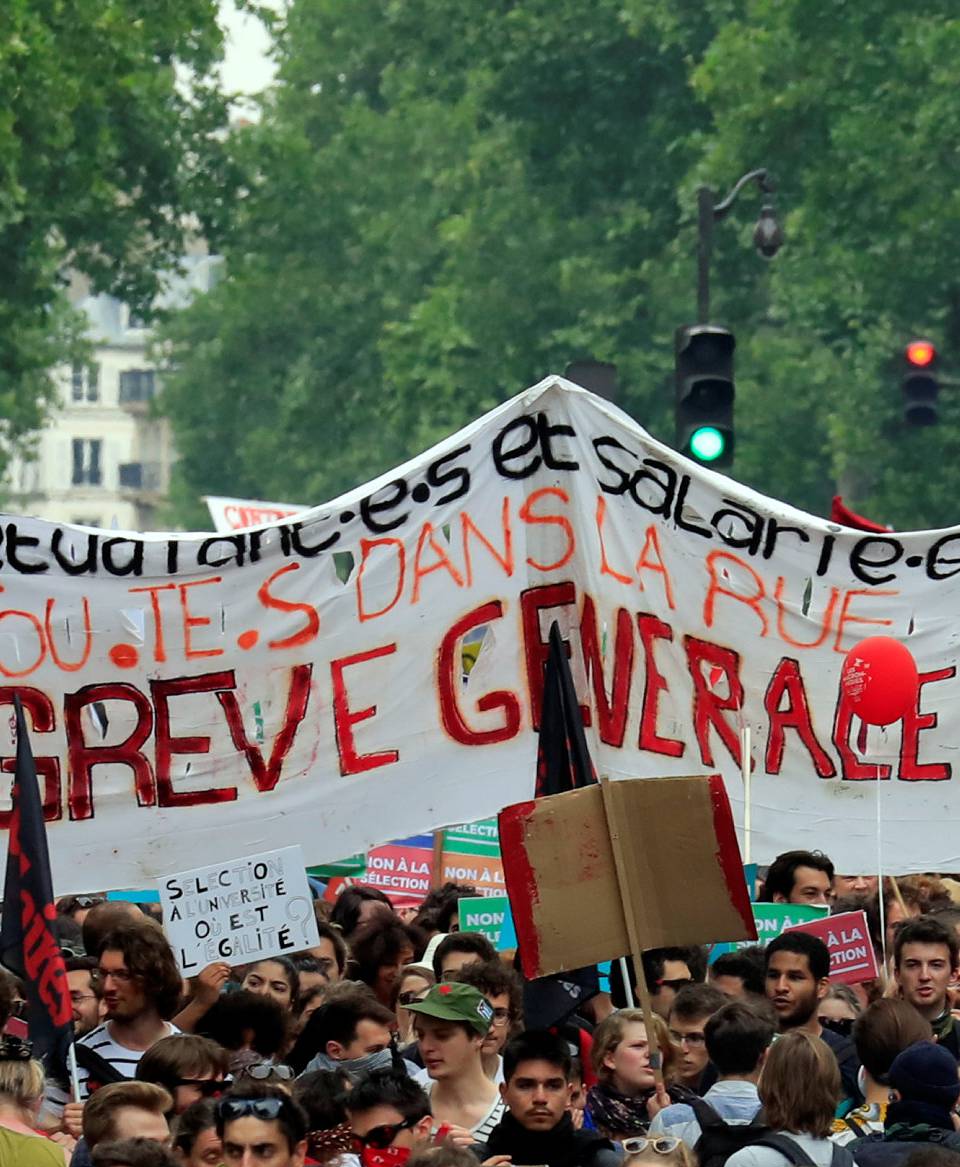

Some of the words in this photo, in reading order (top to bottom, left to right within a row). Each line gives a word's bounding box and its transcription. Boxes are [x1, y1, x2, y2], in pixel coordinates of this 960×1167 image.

[491, 412, 580, 480] et
[0, 562, 320, 678] OU.TE.S
[356, 486, 575, 623] DANS
[596, 495, 676, 610] LA
[704, 549, 899, 653] RUE
[411, 862, 430, 875] LA
[445, 866, 477, 881] NON
[479, 868, 492, 883] À
[494, 872, 505, 884] L
[360, 871, 429, 890] SÉLECTION
[170, 901, 182, 922] À
[229, 905, 269, 931] EST
[466, 912, 505, 927] NON
[827, 930, 840, 947] À
[842, 927, 864, 942] LA
